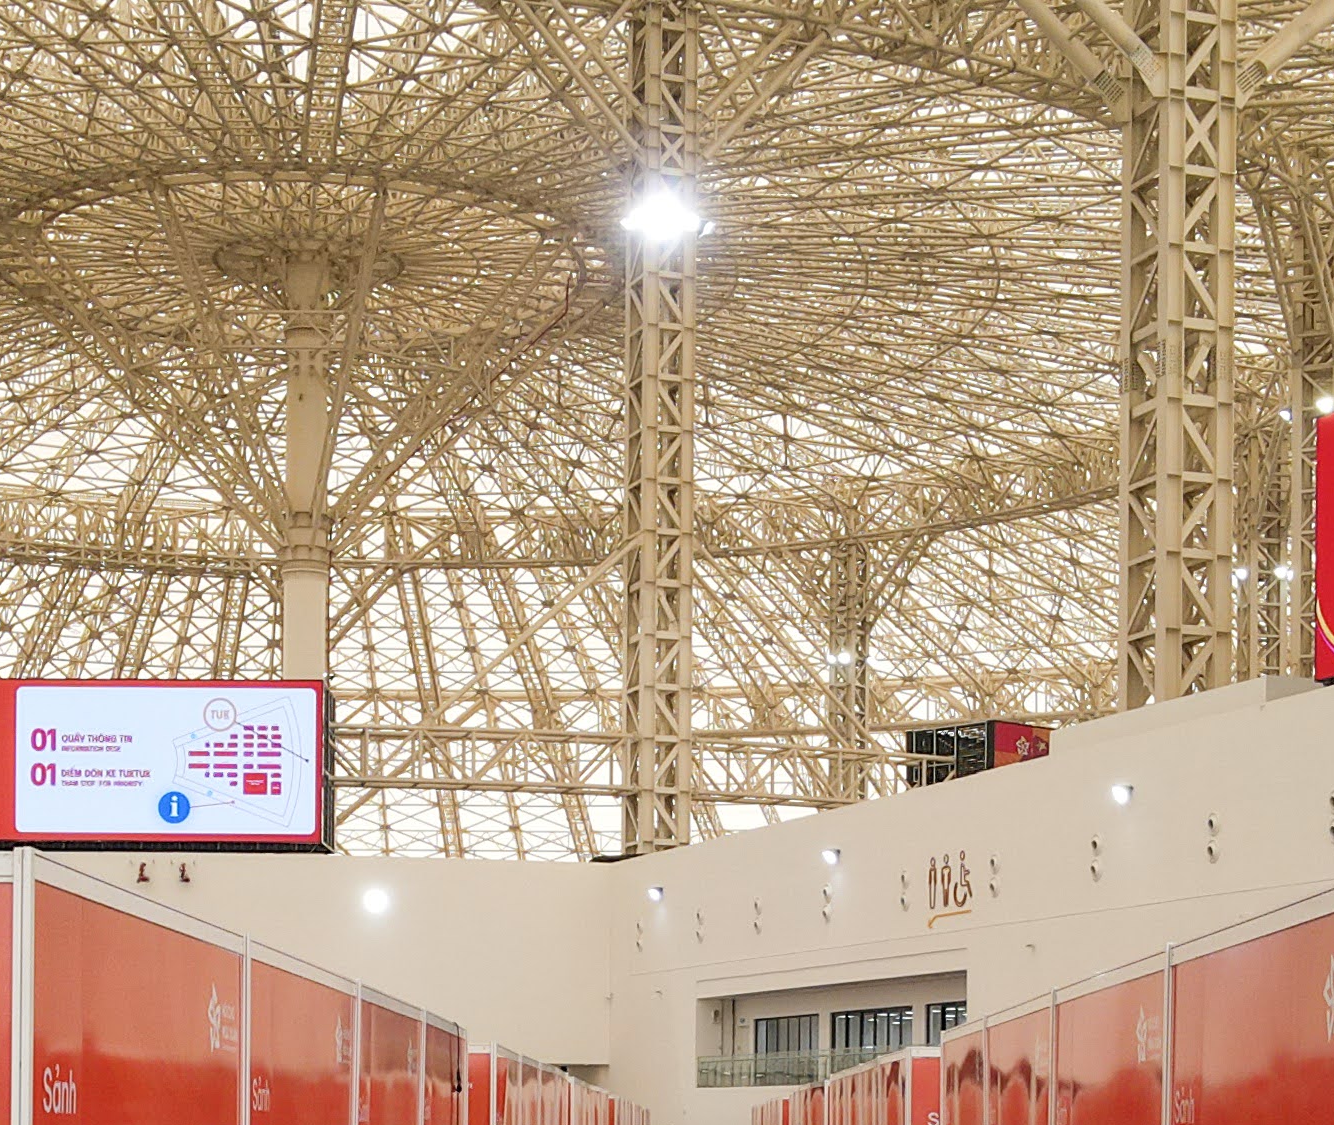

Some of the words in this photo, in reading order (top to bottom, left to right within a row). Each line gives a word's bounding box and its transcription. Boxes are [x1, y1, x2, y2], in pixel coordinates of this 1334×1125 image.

[211, 707, 230, 720] TUK
[30, 727, 57, 752] 01
[30, 762, 57, 787] 01
[43, 1063, 77, 1115] Sảnh
